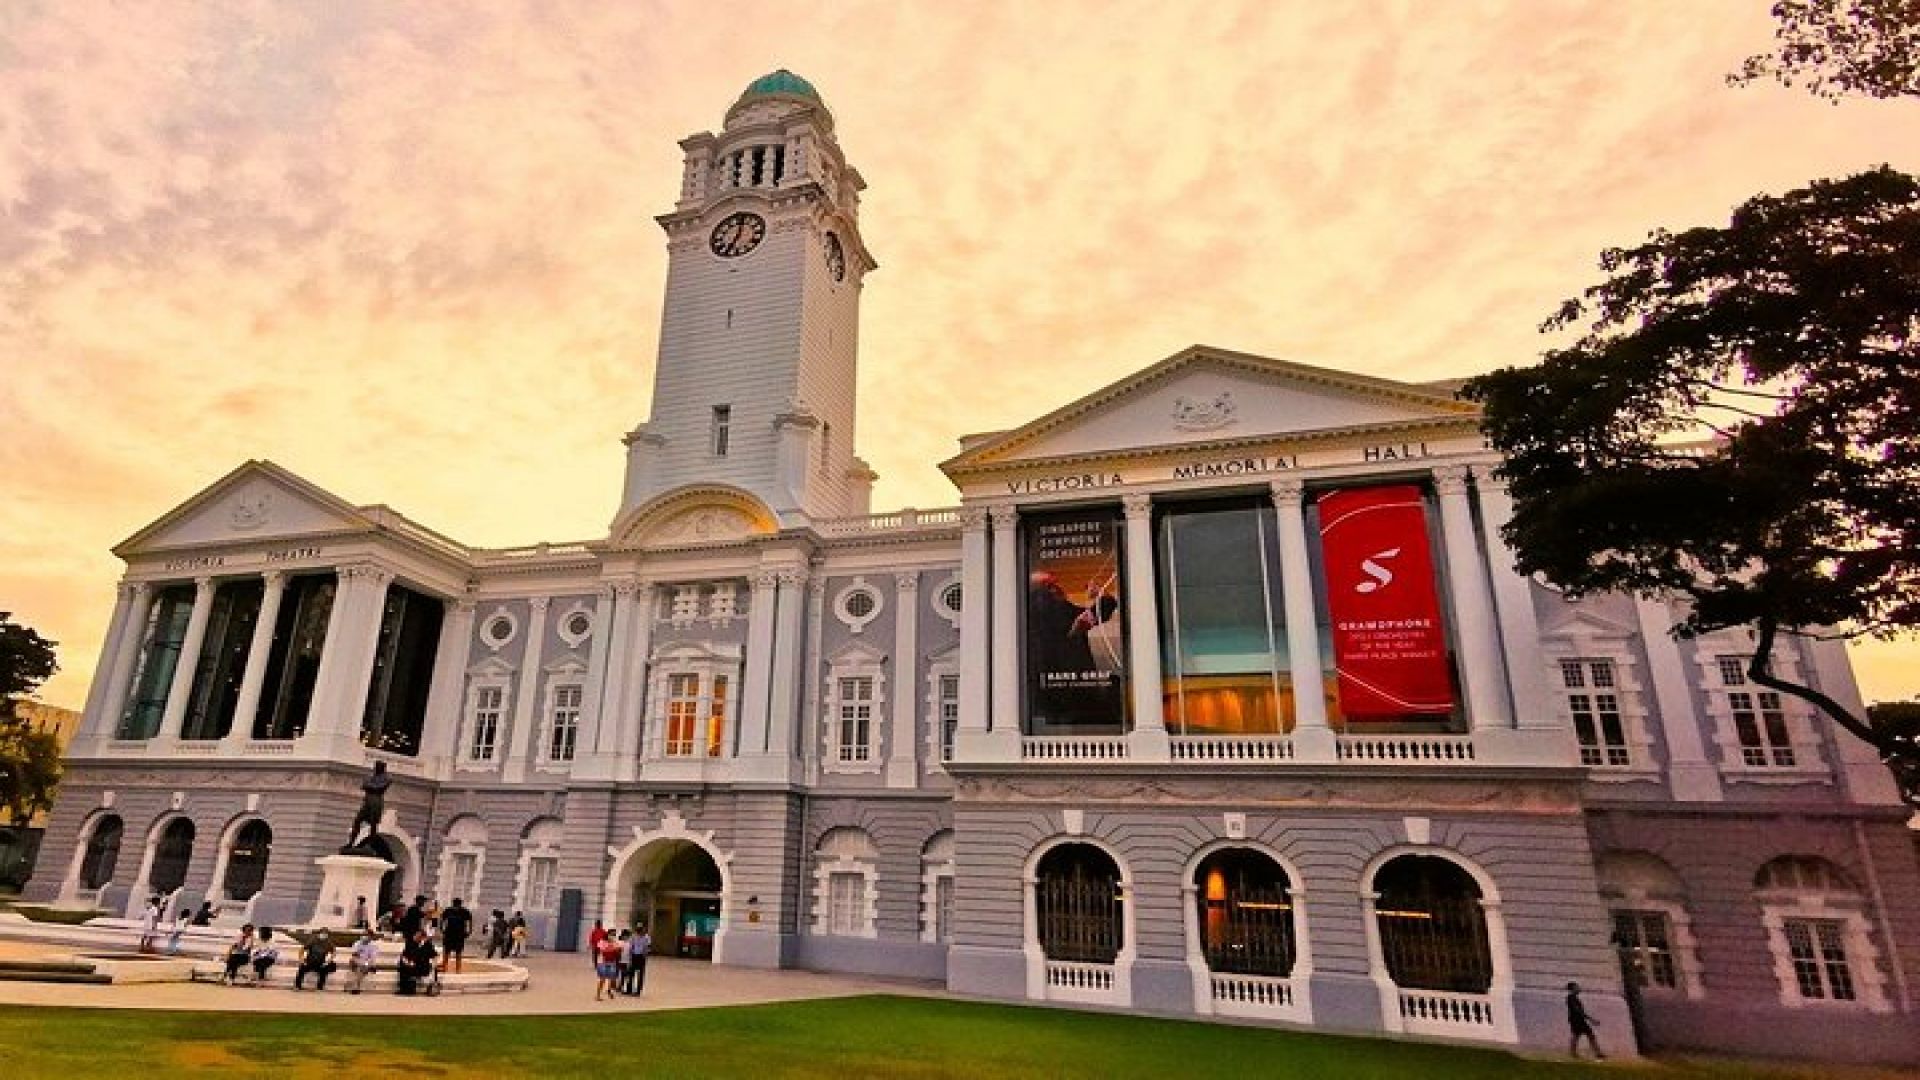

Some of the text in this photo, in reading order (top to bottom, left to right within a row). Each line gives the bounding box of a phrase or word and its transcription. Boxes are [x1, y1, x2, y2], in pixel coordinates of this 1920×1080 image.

[1007, 442, 1428, 494] VICTORIA MEMORIAL HALL
[1338, 619, 1431, 631] GRAMOPHONE
